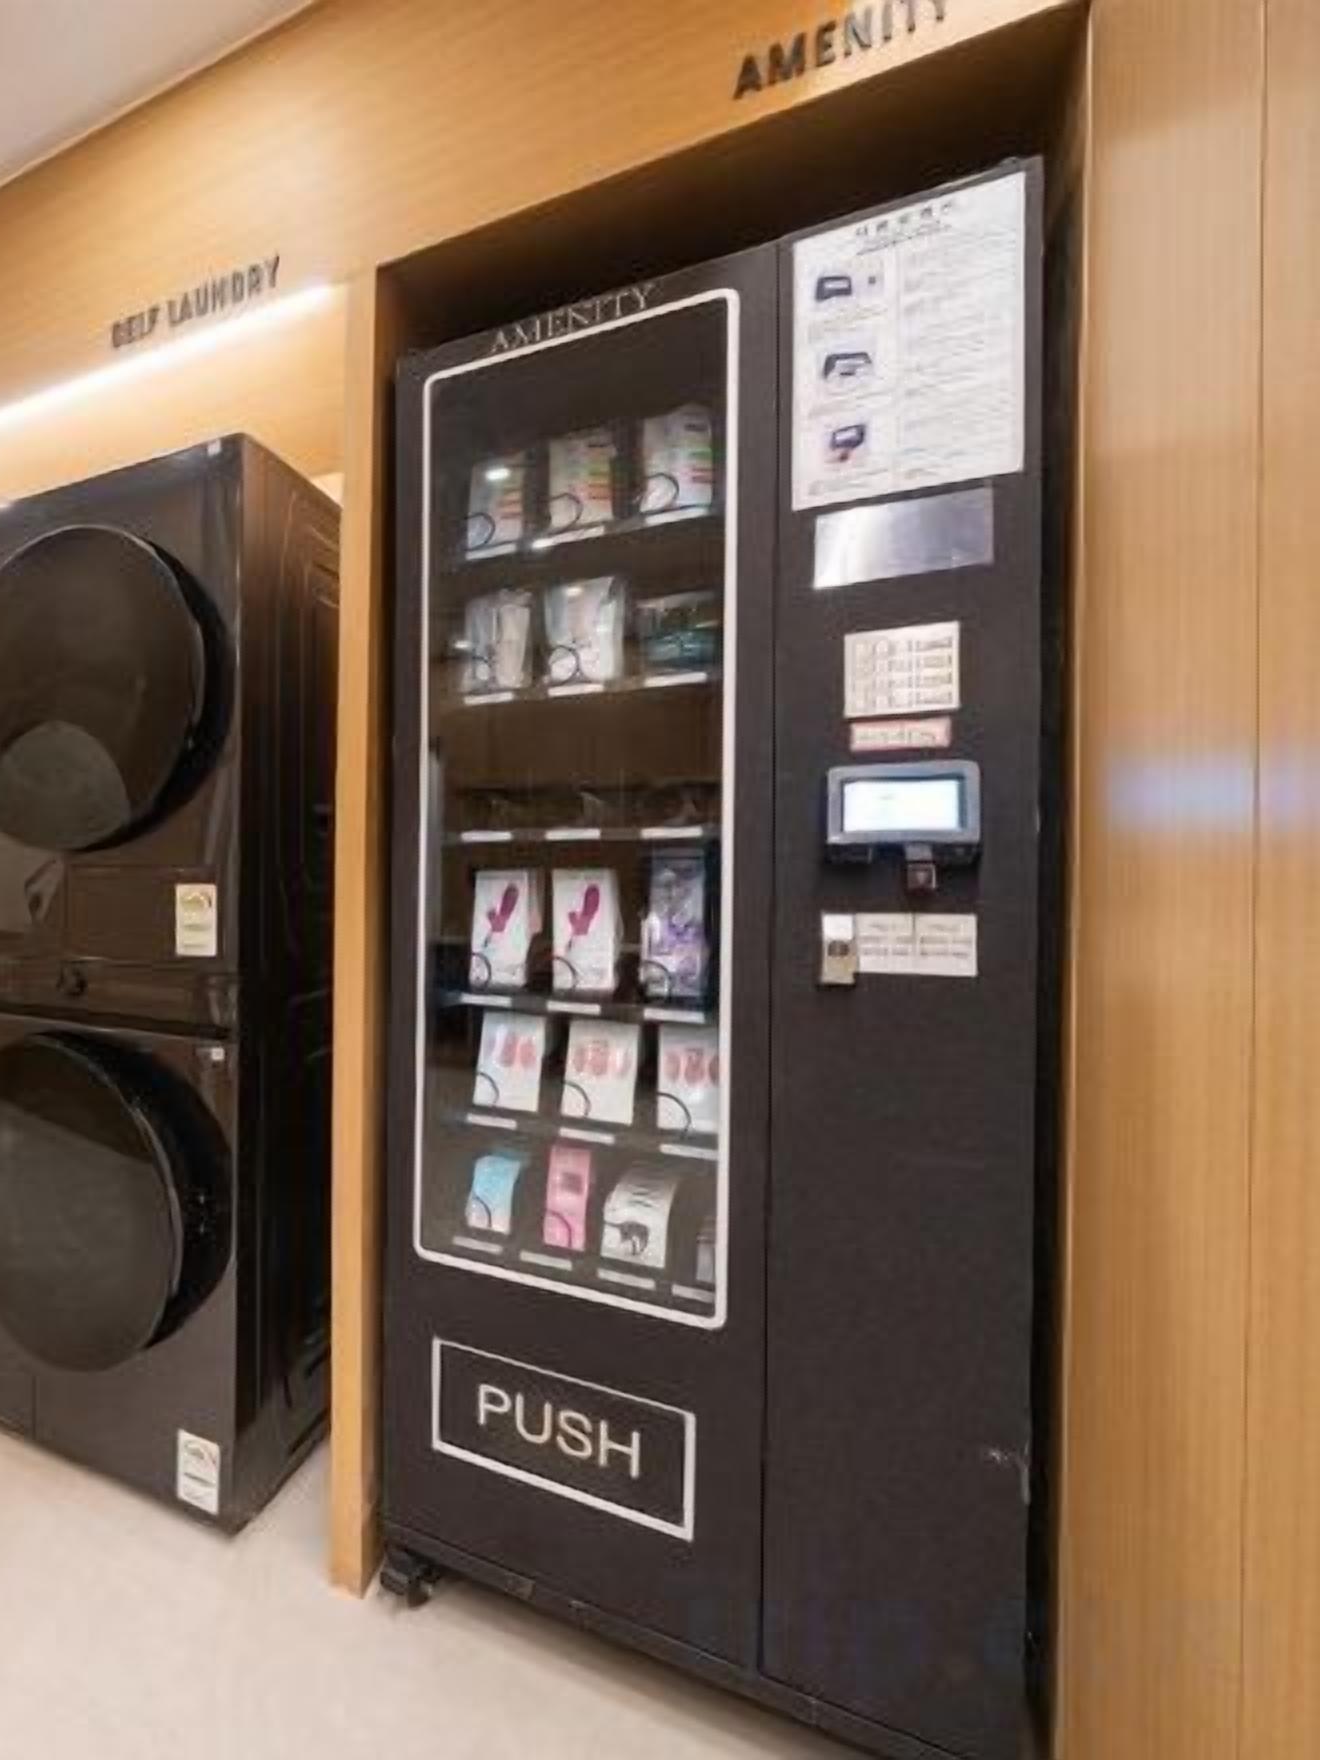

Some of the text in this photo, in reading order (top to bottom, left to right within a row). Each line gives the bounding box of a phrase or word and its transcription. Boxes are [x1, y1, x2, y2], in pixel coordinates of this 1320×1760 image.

[111, 254, 280, 348] SELF LAUNDRY
[490, 283, 655, 353] AMENITY
[477, 1383, 641, 1479] PUSH
